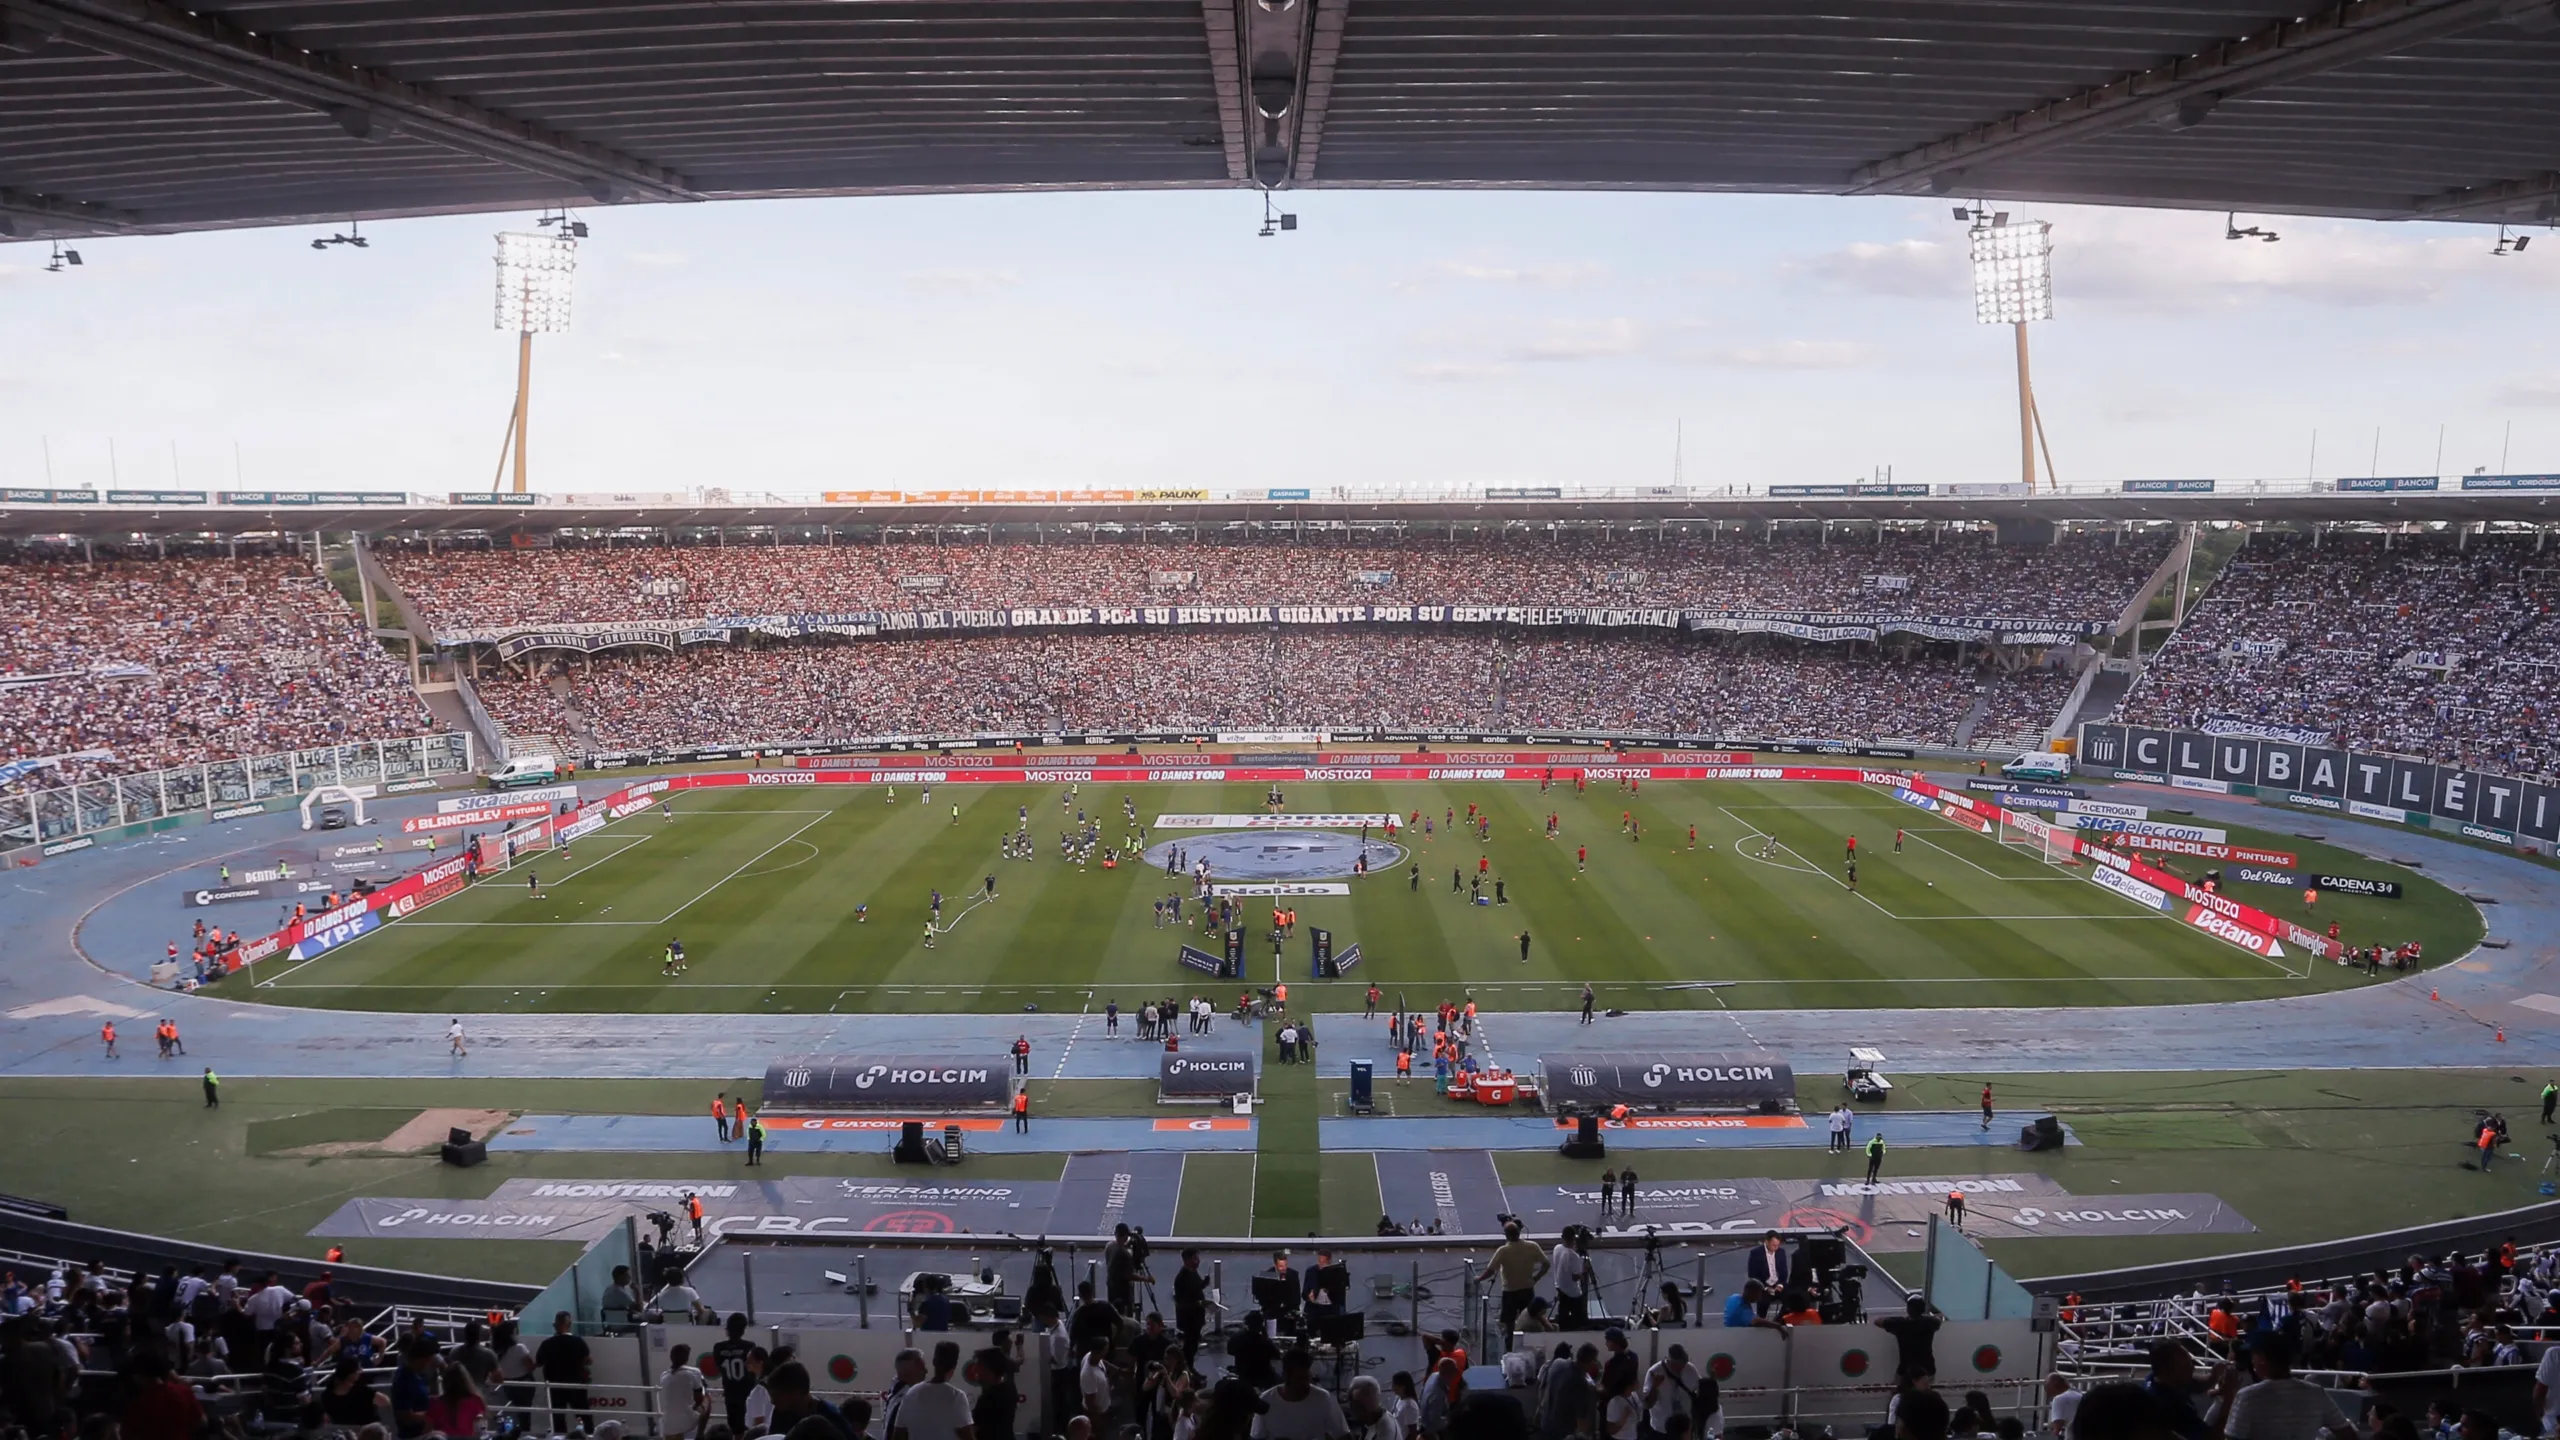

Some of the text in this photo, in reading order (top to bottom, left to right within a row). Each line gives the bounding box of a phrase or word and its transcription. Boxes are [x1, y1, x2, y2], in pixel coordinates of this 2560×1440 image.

[1860, 485, 1888, 493] BANCOR
[1897, 485, 1926, 493] BANCOR
[2135, 481, 2168, 489] BANCOR
[2178, 481, 2211, 489] BANCOR
[2351, 479, 2387, 489] BANCOR
[2398, 478, 2434, 488] BANCOR
[231, 493, 265, 501] BANCOR
[275, 493, 310, 501] BANCOR
[462, 494, 493, 502] BANCOR
[501, 494, 532, 503] BANCOR
[1159, 491, 1202, 499] PAUNY
[881, 610, 1006, 630] AMOR DEL PUEBLO
[1011, 606, 1521, 627] GRANDE POR SU HISTORIA GIGANTE POR SU GENTE
[1520, 608, 1679, 629] FIELES HASTA LA INCONSCIENCIA
[1808, 613, 1932, 625] INTERNACIONAL
[1938, 617, 1959, 626] DE
[1963, 619, 1984, 629] LA
[1990, 620, 2084, 632] PROVINCIA
[807, 624, 866, 637] CORDOBA
[1741, 620, 1767, 631] AMOR
[1770, 621, 1808, 638] EXPLICA
[1810, 628, 1834, 641] ESTA
[1836, 627, 1872, 641] LOCURA
[522, 636, 536, 647] LA
[598, 632, 660, 643] CORDOBESA
[1816, 746, 1848, 754] CADENA
[822, 758, 852, 768] DAMOS
[1038, 756, 1069, 765] DAMOS
[1341, 755, 1372, 764] DAMOS
[1559, 754, 1590, 763] DAMOS
[2136, 736, 2292, 782] CLUB
[870, 772, 946, 783] LO DAMOS TODO
[1148, 771, 1225, 781] LO DAMOS TODO
[1428, 769, 1505, 779] LO DAMOS TODO
[1706, 768, 1783, 779] LO DAMOS TODO
[2113, 771, 2165, 784] CORDOBESA
[1902, 788, 1929, 806] YPF
[2033, 786, 2075, 797] ADVANTA
[456, 790, 562, 812] sicaelec.com
[620, 795, 652, 816] Betano
[2014, 797, 2059, 809] CETROGAR
[2290, 794, 2341, 810] CORDOBESA
[212, 804, 265, 821] CORDOBESA
[2089, 805, 2137, 818] CETROGAR
[417, 808, 501, 830] BLANCALEY
[2076, 814, 2203, 842] sicaelec.com
[2463, 826, 2513, 845] CORDOBESA
[2129, 834, 2289, 866] BLANCALEY PINTURAS
[2240, 868, 2293, 886] Del Pilar
[2321, 876, 2376, 892] CADENA
[2094, 866, 2163, 907] sicaelec.com
[214, 888, 260, 900] CONTIGIANI
[303, 899, 367, 939] LO DAMOS TODO
[313, 919, 364, 949] YPF
[2194, 908, 2264, 951] Betano
[2288, 923, 2328, 956] Schneider
[237, 935, 280, 966] Schneider
[1189, 1061, 1246, 1072] HOLCIM
[890, 1068, 988, 1085] HOLCIM
[1677, 1066, 1774, 1083] HOLCIM
[1635, 1119, 1748, 1129] GATORADE
[530, 1184, 741, 1198] MONTIRONI
[847, 1186, 1013, 1197] TERRAWIND
[1106, 1172, 1132, 1208] TALLERES
[1429, 1171, 1456, 1207] TALLERES
[1819, 1178, 2026, 1197] MONTIRONI
[425, 1214, 557, 1227] HOLCIM
[2053, 1207, 2187, 1223] HOLCIM
[720, 1358, 745, 1381] 10
